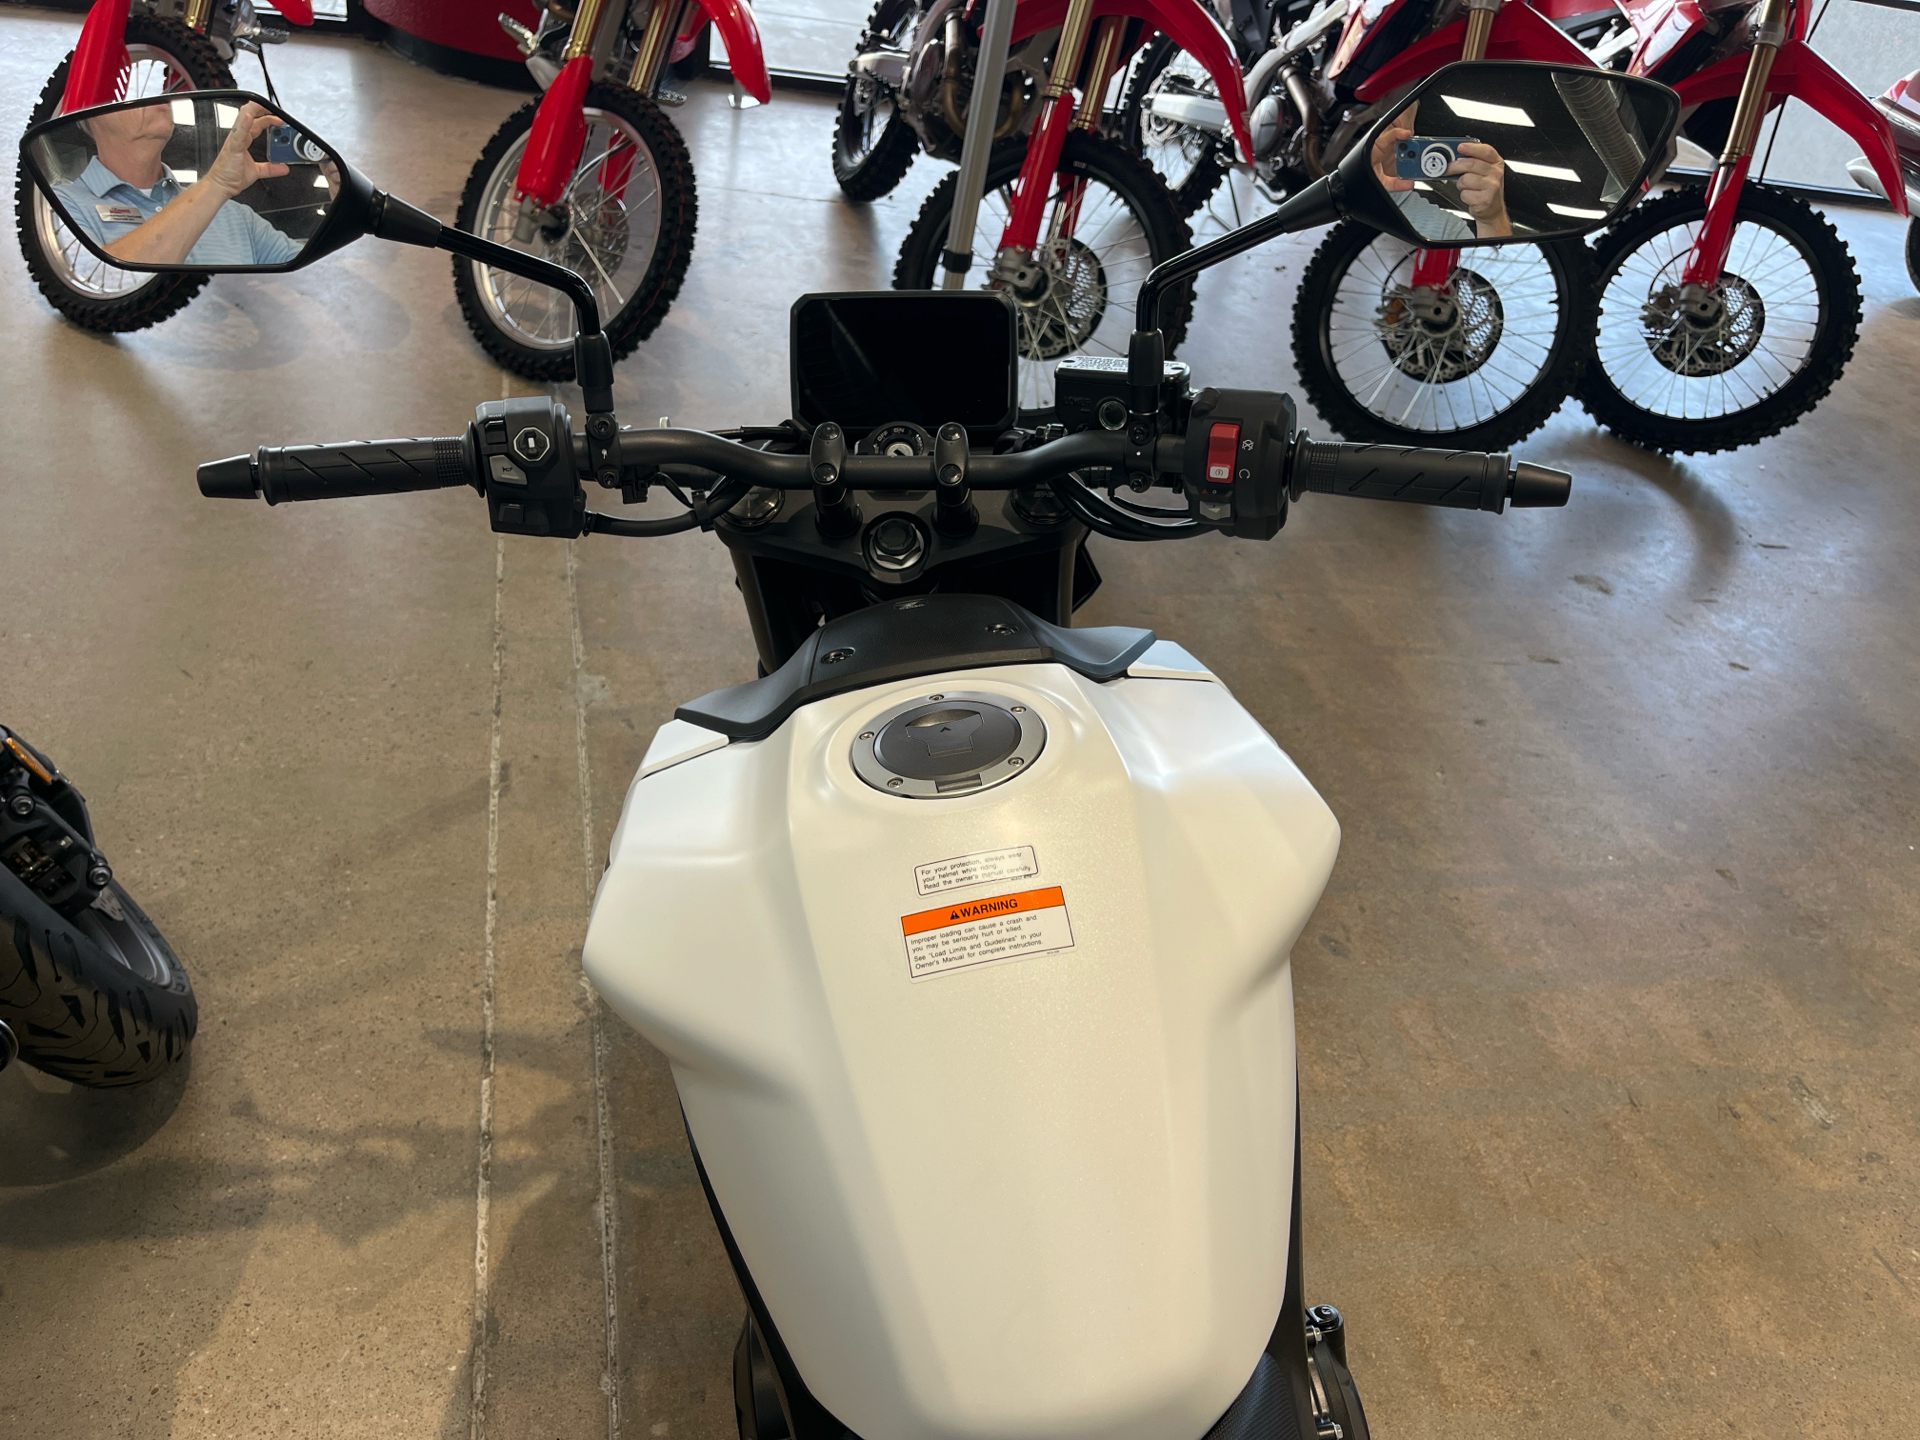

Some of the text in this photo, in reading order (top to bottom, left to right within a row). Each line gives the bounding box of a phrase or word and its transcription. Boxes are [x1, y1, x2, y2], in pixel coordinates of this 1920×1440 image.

[877, 430, 888, 442] OFF
[922, 876, 936, 884] your
[938, 870, 959, 879] helmet
[934, 866, 948, 874] your
[924, 882, 940, 890] Read
[955, 874, 978, 883] owner's
[960, 899, 1018, 917] WARNING
[910, 934, 937, 946] Improper
[940, 929, 962, 938] loading
[978, 922, 996, 930] cause
[952, 934, 978, 944] seriously
[914, 954, 926, 962] See
[949, 946, 967, 954] Limits
[1030, 932, 1042, 940] your
[916, 960, 940, 970] Owner's
[942, 954, 964, 964] Manual
[978, 945, 1006, 956] complete
[1009, 940, 1043, 950] instructions.
